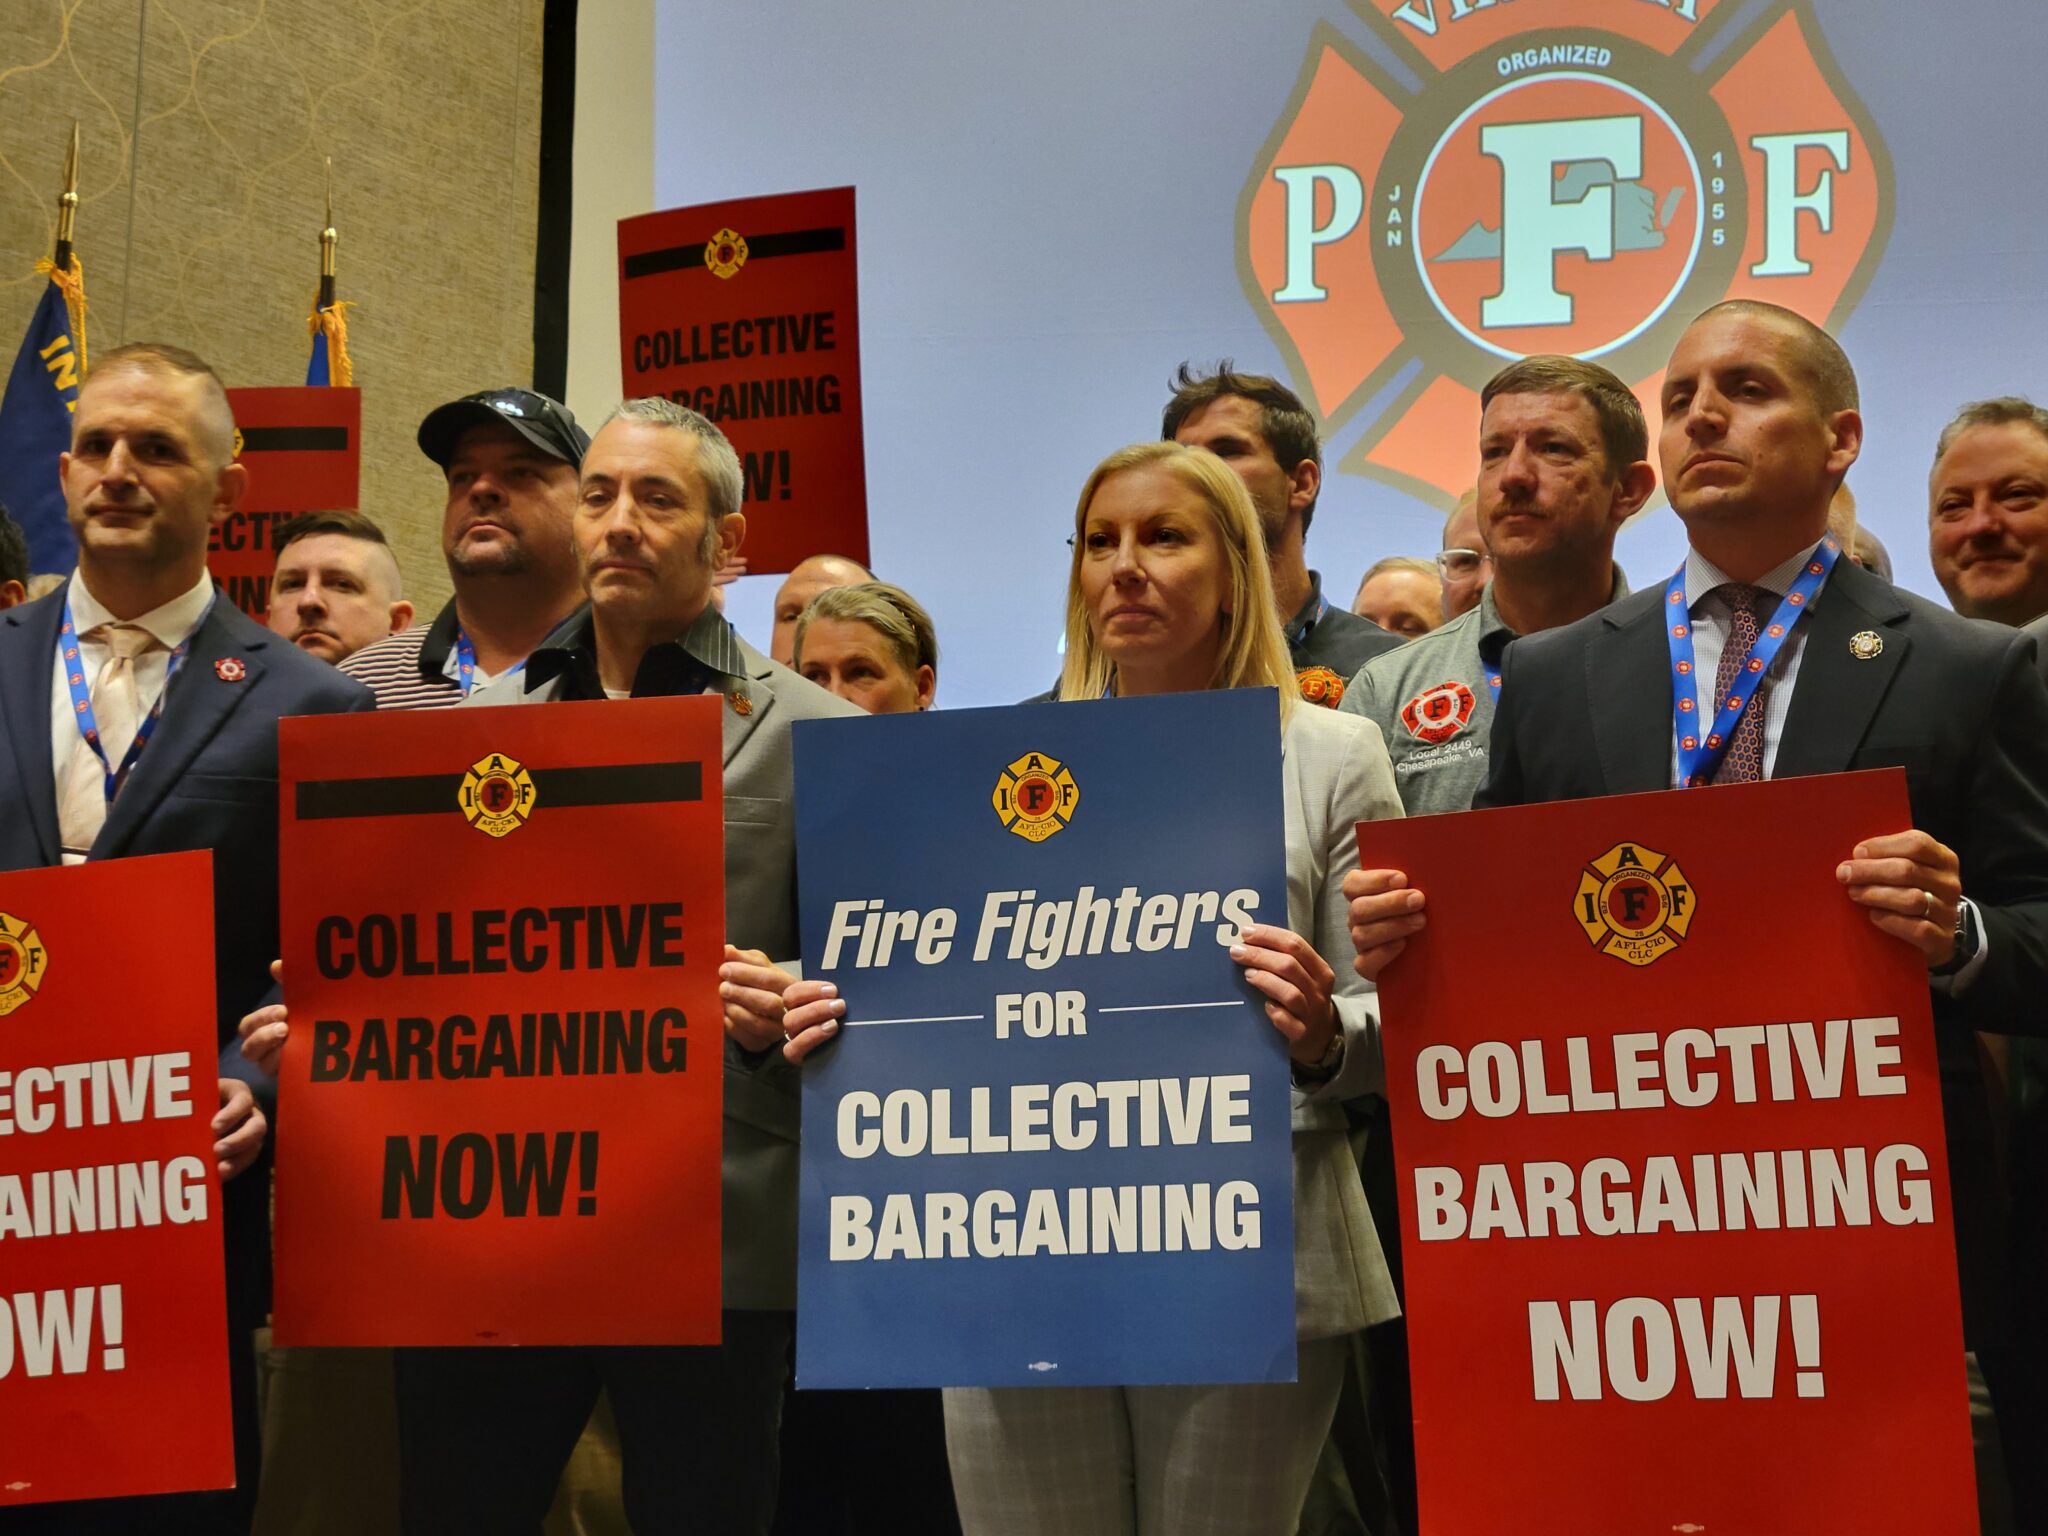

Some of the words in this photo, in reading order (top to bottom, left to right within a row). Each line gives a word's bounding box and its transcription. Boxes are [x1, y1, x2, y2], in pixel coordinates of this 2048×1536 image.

[1497, 45, 1611, 76] ORGANIZED
[1273, 164, 1363, 303] P
[1480, 114, 1643, 330] F
[1750, 130, 1851, 277] F
[1387, 184, 1402, 247] JAN
[1712, 151, 1725, 246] 1955
[634, 311, 836, 373] COLLECTIVE
[641, 375, 841, 422] GAINING
[1409, 746, 1440, 761] Local
[1444, 739, 1472, 754] 2449
[1468, 747, 1485, 758] VA
[1617, 847, 1644, 868] A
[821, 899, 957, 970] Fire
[973, 886, 1260, 970] Fighters
[1620, 887, 1649, 921] F
[1669, 884, 1688, 916] F
[315, 902, 684, 980] COLLECTIVE
[1614, 936, 1667, 950] AFL-CIO
[1628, 949, 1654, 959] CLC
[310, 1008, 688, 1083] BARGAINING
[996, 991, 1087, 1039] FOR
[1415, 1016, 1907, 1121] COLLECTIVE
[837, 1074, 1252, 1159] COLLECTIVE
[381, 1131, 600, 1219] NOW!
[1413, 1143, 1935, 1242] BARGAINING
[829, 1180, 1261, 1261] BARGAINING
[1527, 1294, 1825, 1401] NOW!
